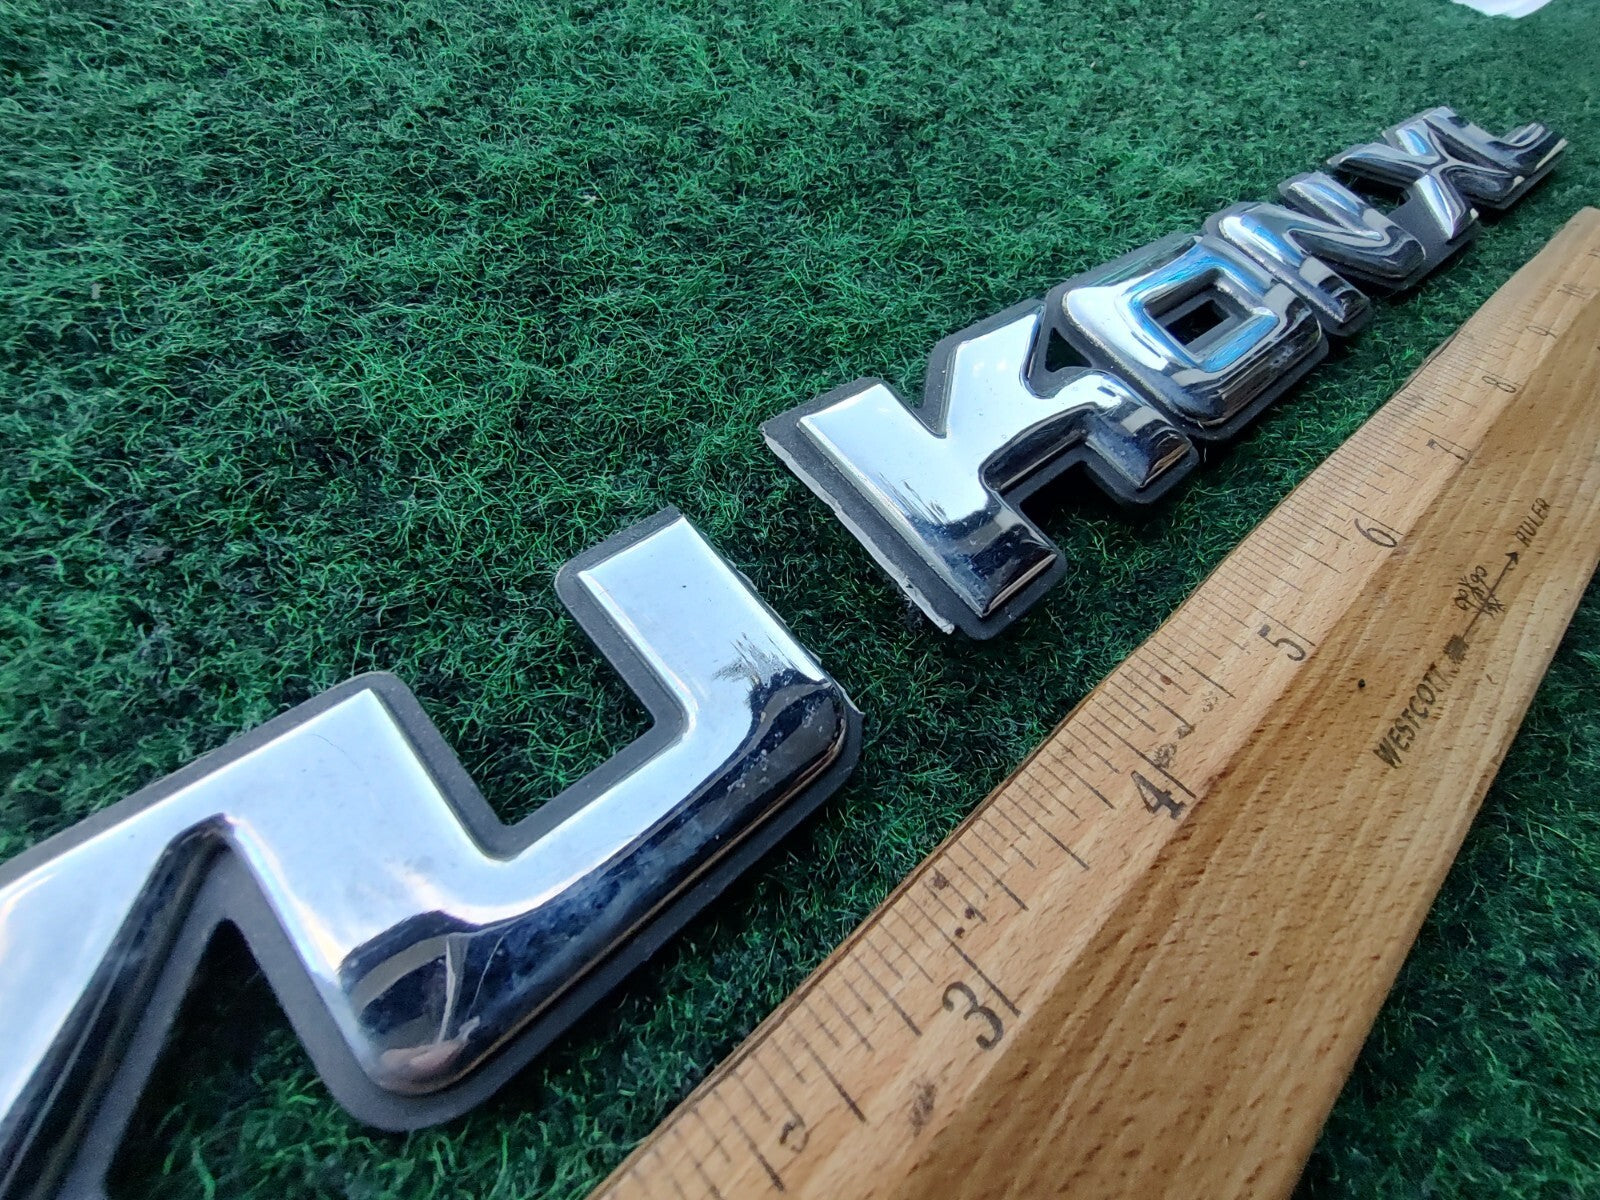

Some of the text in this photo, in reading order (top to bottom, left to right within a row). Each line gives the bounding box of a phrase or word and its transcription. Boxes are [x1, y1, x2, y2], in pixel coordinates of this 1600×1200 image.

[941, 980, 1005, 1051] 3
[1131, 769, 1187, 820] 4
[1257, 623, 1307, 662] 5
[1354, 517, 1399, 549] 6
[1425, 437, 1466, 461] 7
[1481, 374, 1518, 395] 8
[1525, 325, 1559, 340] 9
[1372, 496, 1552, 770] WESTCOTT RULER
